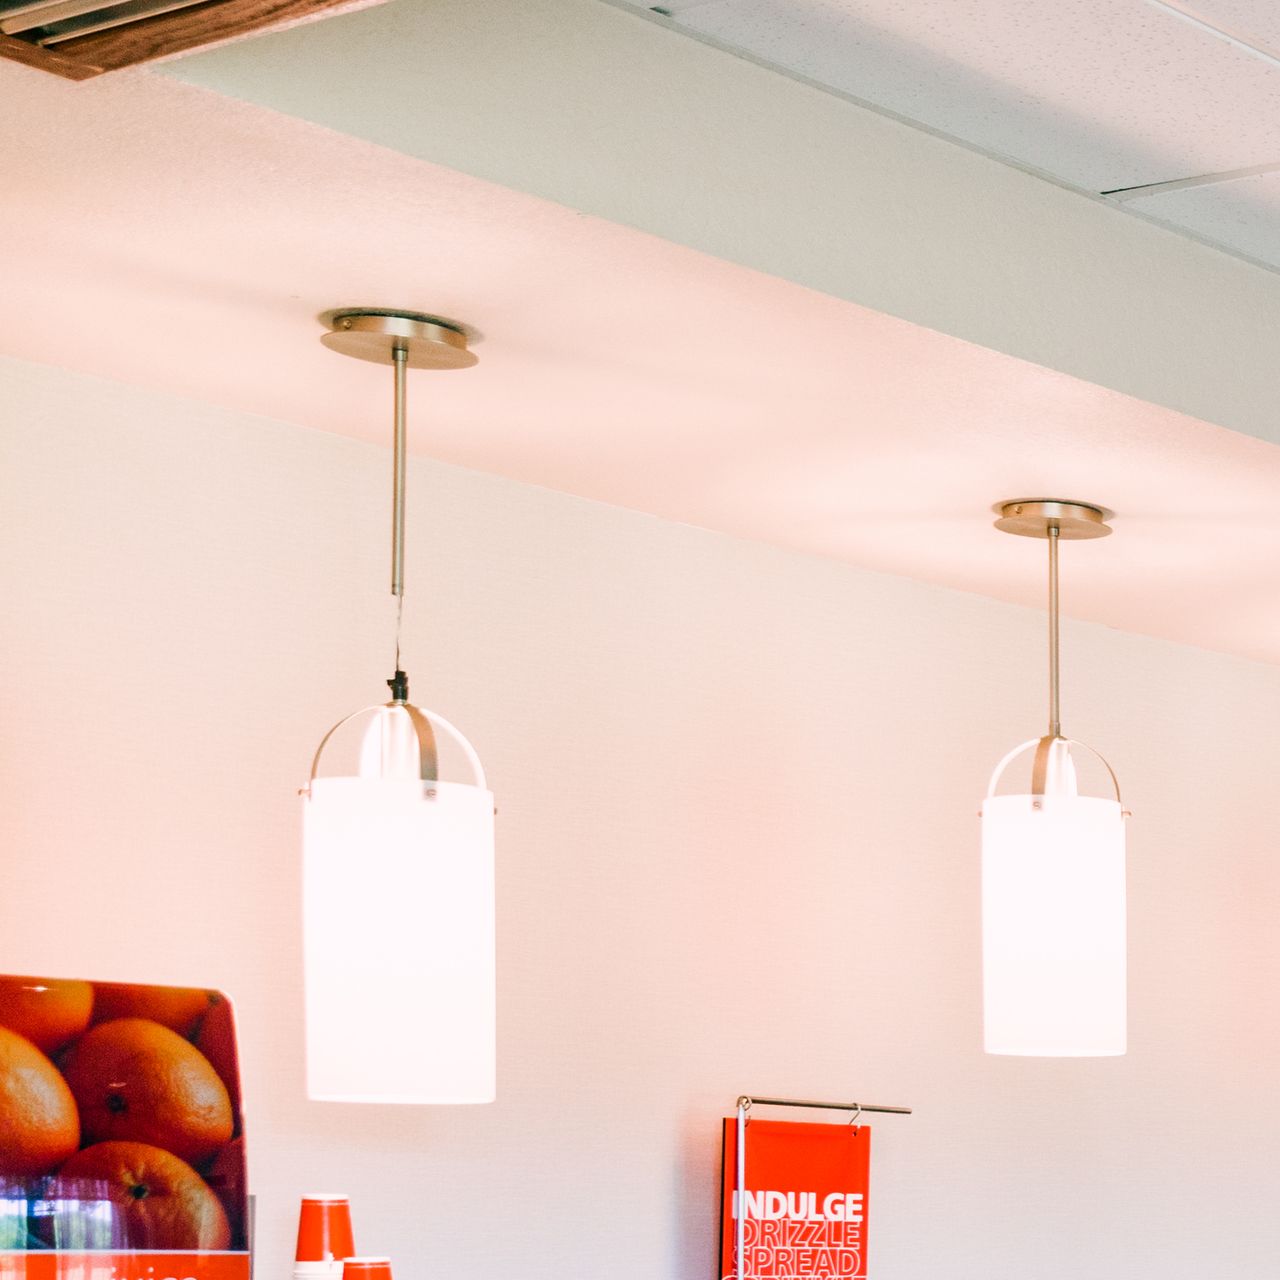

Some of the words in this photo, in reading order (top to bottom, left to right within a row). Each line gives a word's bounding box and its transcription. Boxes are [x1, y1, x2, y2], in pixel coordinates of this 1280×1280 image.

[732, 1190, 863, 1222] INDULGE
[733, 1218, 860, 1249] DRIZZLE
[732, 1246, 861, 1277] SPREAD
